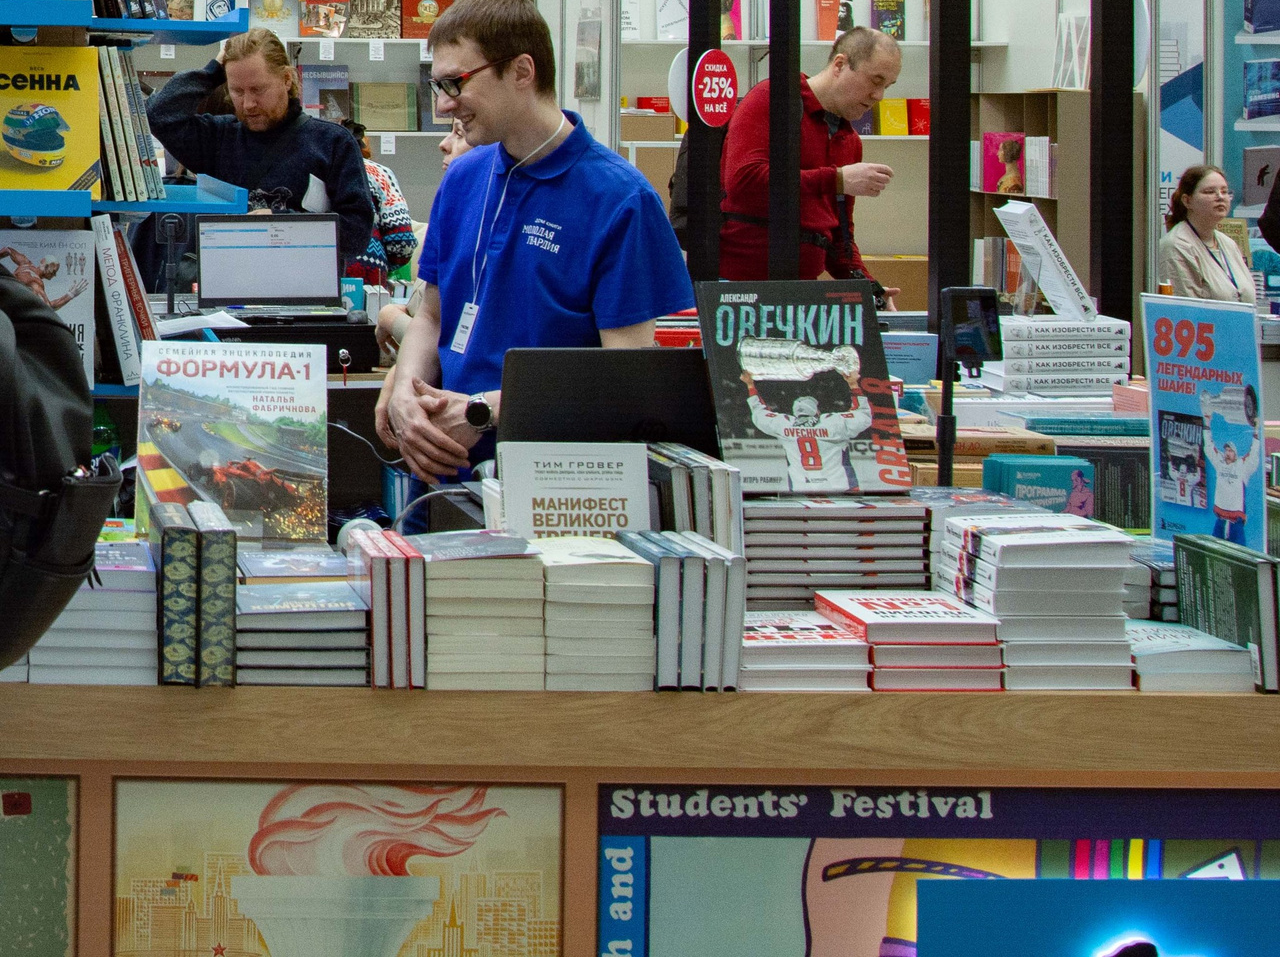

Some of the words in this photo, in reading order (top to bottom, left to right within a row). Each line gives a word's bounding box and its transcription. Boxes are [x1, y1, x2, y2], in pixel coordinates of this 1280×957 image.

[704, 64, 727, 72] СКИДКА
[698, 77, 734, 99] -25%
[704, 104, 714, 113] НА
[715, 102, 727, 113] ВСЁ
[522, 224, 555, 241] МОЛОДАЯ
[101, 247, 120, 287] МЕТОД
[1043, 233, 1057, 250] КАК
[1052, 250, 1077, 288] ИЗОБРЕСТИ
[1075, 287, 1085, 302] ВСЕ
[121, 257, 142, 302] ТРИГГЕРНЫЕ
[135, 301, 150, 327] ТОЧКИ
[720, 293, 758, 303] АЛЕКСАНДР
[110, 289, 134, 360] ФРАНКЛИНА
[716, 303, 864, 347] ОВЕЧКИН
[1154, 317, 1215, 362] 895
[158, 347, 216, 356] СЕМЕЙНАЯ
[223, 349, 312, 358] ЭНЦИКЛОПЕДИЯ
[157, 357, 311, 381] ФОРМУЛА-1
[1156, 362, 1243, 386] ЛЕГЕНДАРНЫХ
[1158, 376, 1196, 394] ШАЙБ!
[252, 395, 295, 403] НАТАЛЬЯ
[252, 404, 317, 413] ФАБРИЧНОВА
[784, 428, 829, 438] OVECHKIN
[1160, 416, 1203, 446] ОВЕЧКИН
[797, 437, 822, 471] 8
[872, 406, 912, 487] GREAT
[534, 461, 561, 469] ТИМ
[568, 461, 624, 469] ГРОВЕР
[743, 476, 758, 484] ИГОРЬ
[759, 476, 782, 484] РАБИНЕР
[532, 497, 628, 511] МАНИФЕСТ
[532, 513, 629, 528] ВЕЛИКОГО
[533, 530, 619, 539] ТРЕНЕР
[610, 788, 809, 820] Students'
[829, 789, 994, 820] Festival
[606, 846, 635, 921] and
